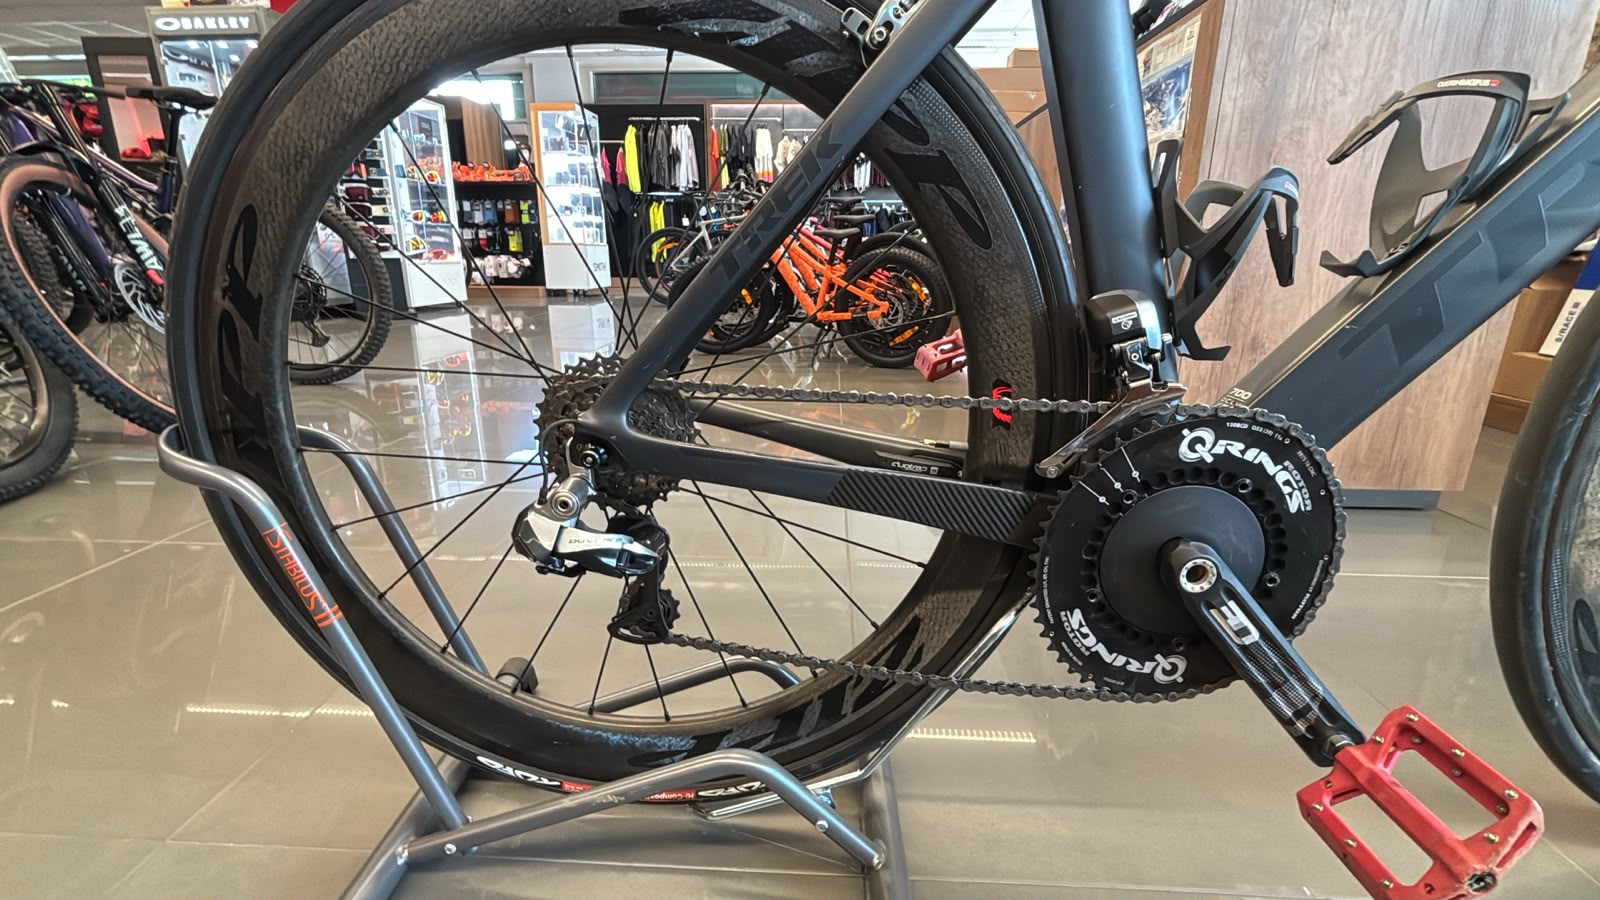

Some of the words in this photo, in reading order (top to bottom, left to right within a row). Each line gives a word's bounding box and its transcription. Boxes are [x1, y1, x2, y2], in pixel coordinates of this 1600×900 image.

[179, 16, 250, 30] OAKLEY
[709, 123, 843, 280] TREK
[1229, 388, 1253, 400] 700
[1283, 460, 1313, 511] ROTOR
[265, 527, 325, 611] STABILUS
[476, 754, 562, 787] TUFO
